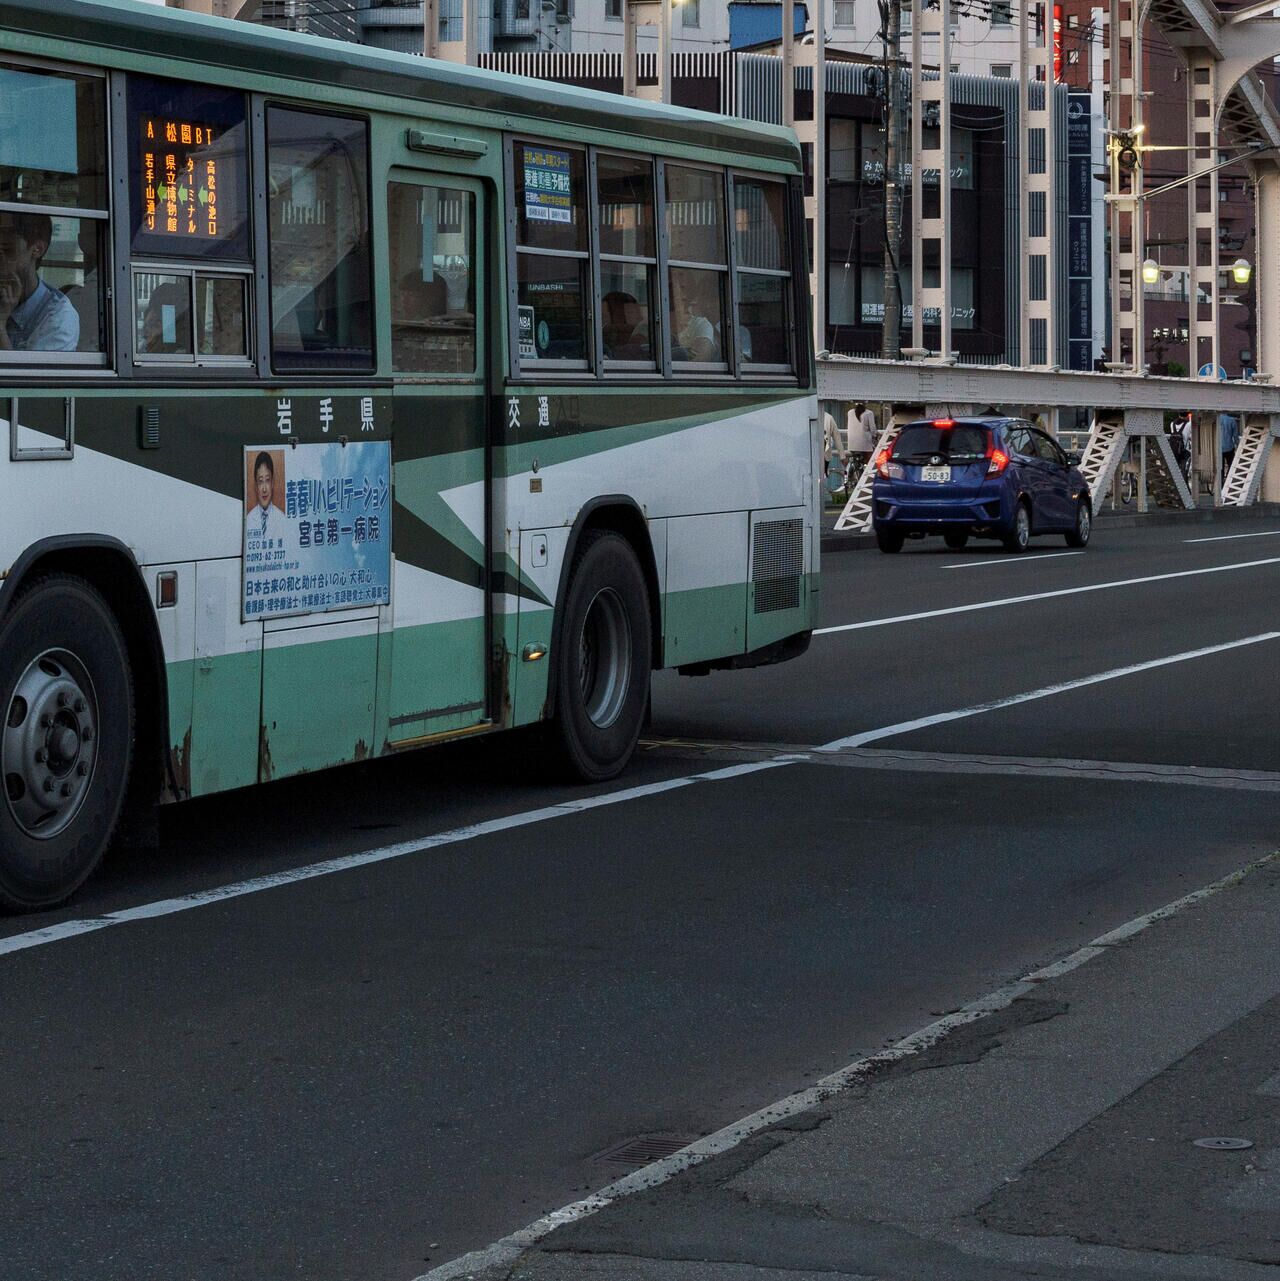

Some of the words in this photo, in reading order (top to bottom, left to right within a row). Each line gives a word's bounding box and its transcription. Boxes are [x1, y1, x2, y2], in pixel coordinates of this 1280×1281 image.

[147, 121, 154, 138] A
[145, 153, 155, 230] 岩手山通り
[166, 154, 177, 232] 県立博物館
[187, 158, 196, 233] ターミナル
[277, 397, 375, 434] 岩手県
[509, 396, 550, 428] 交通
[286, 475, 389, 518] 青春リハビリテーション
[298, 515, 380, 548] 宮古第一病院
